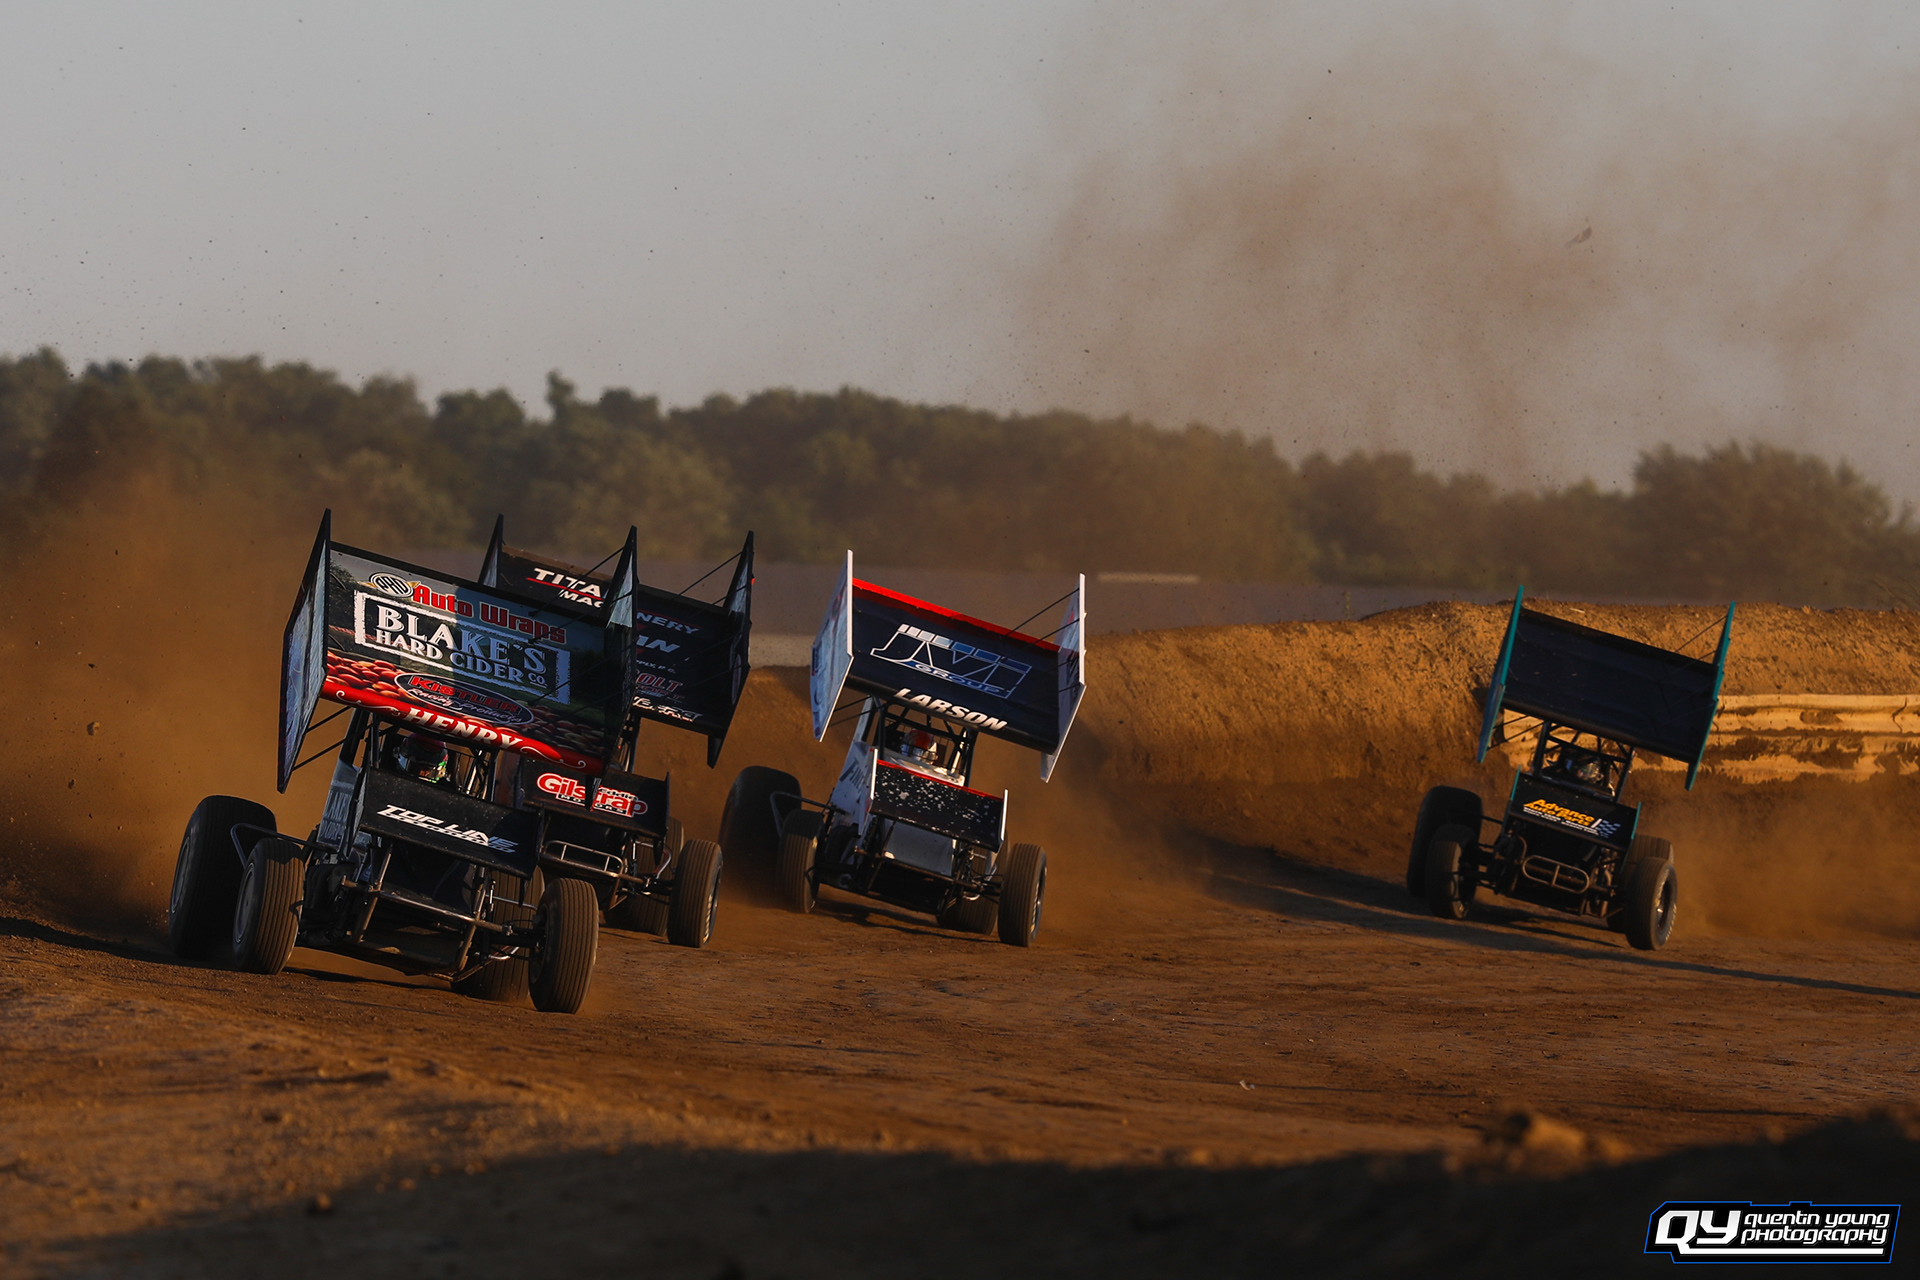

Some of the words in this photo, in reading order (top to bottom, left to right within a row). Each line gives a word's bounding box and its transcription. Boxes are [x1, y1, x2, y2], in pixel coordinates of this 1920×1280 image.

[533, 567, 604, 599] TITA
[413, 585, 474, 618] Auto
[479, 601, 566, 645] Wraps
[376, 604, 547, 674] BLAKE'S
[376, 629, 444, 660] HARD
[450, 651, 524, 683] CIDER
[410, 675, 519, 714] KISTLER
[914, 663, 1001, 695] GROUP
[403, 707, 523, 750] HENRY
[893, 687, 1008, 731] LARSON
[560, 794, 624, 814] MOORS
[1523, 802, 1556, 815] Auto
[1556, 811, 1591, 827] Parts
[1531, 799, 1595, 822] Advance
[380, 804, 444, 824] TOP
[444, 824, 518, 847] LINE
